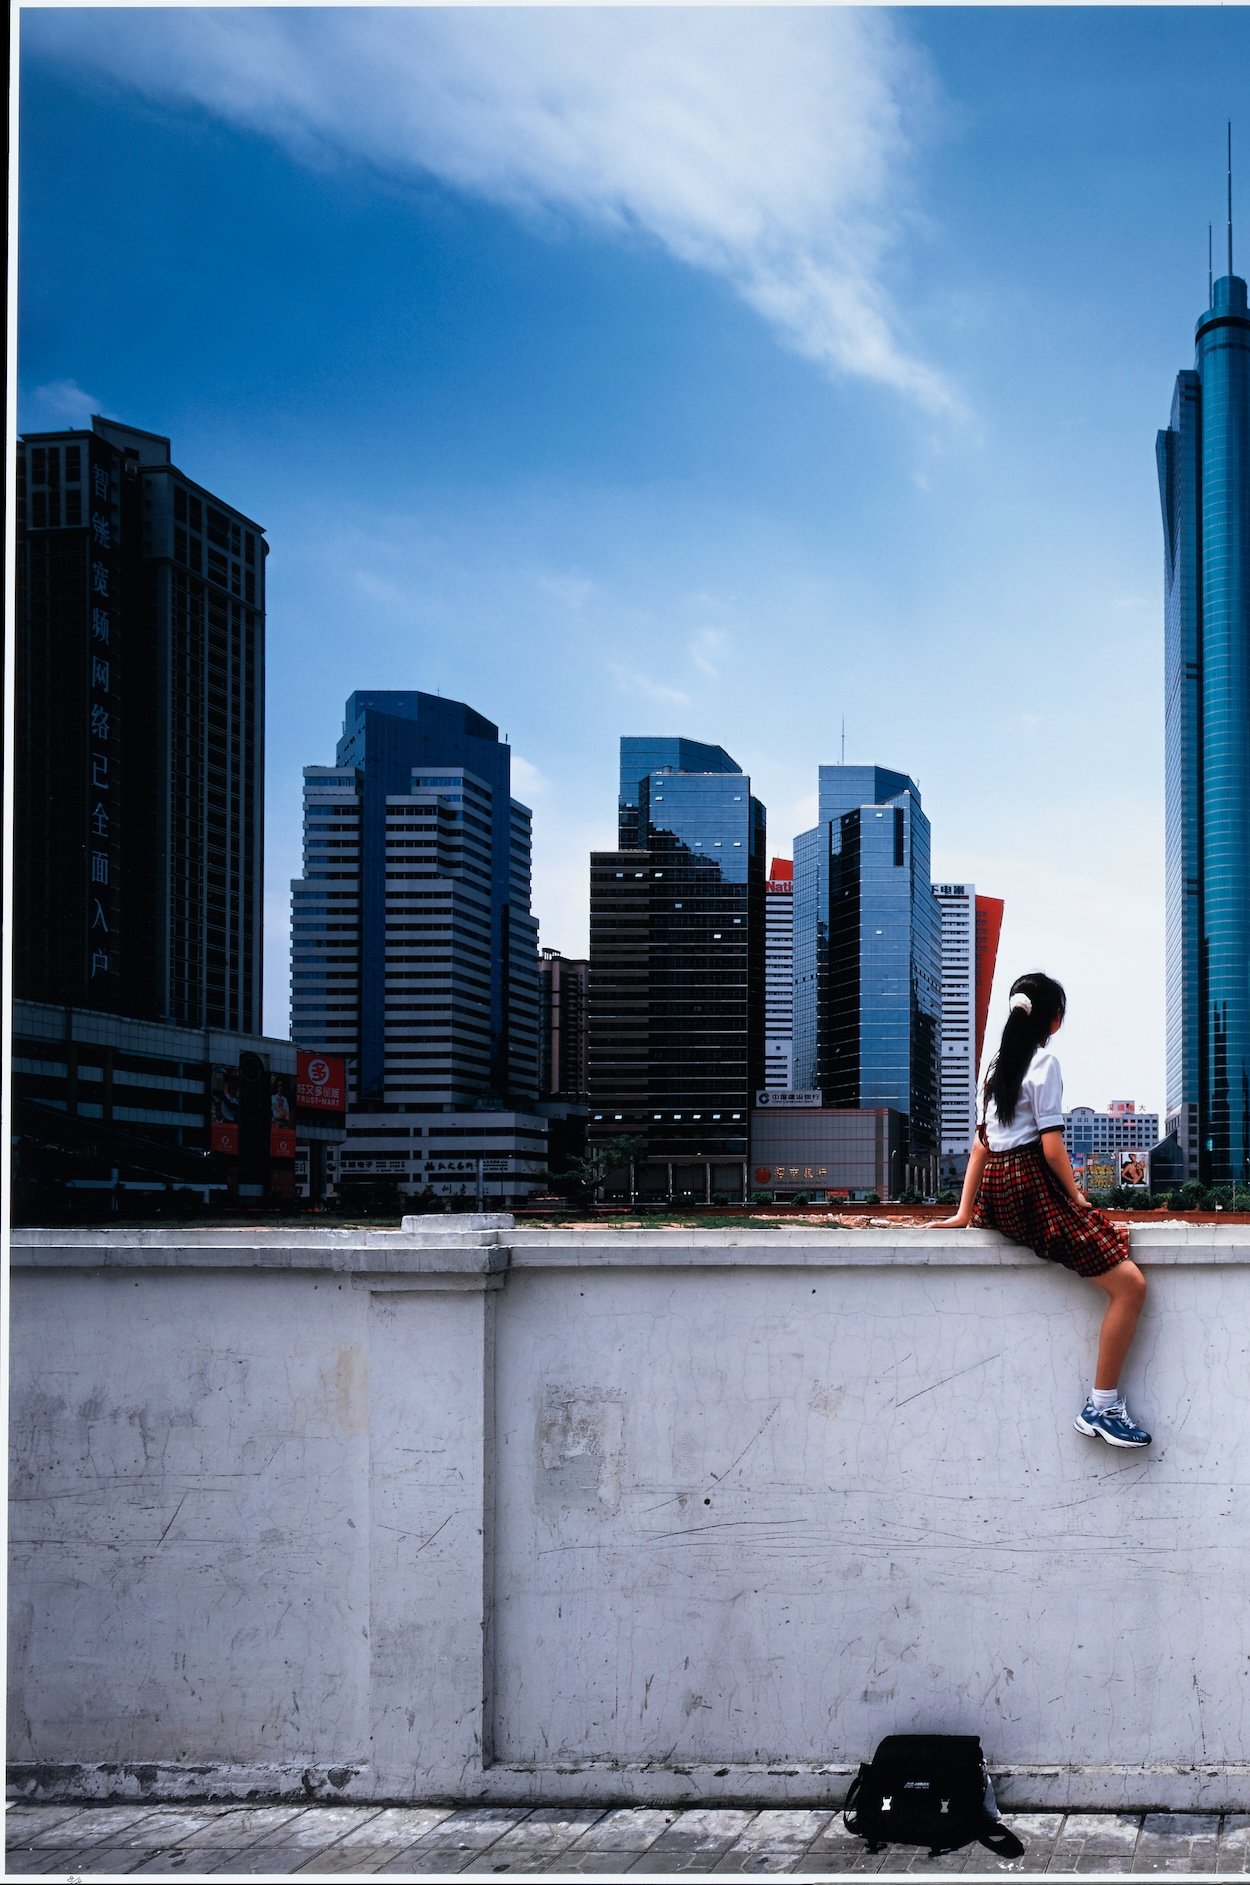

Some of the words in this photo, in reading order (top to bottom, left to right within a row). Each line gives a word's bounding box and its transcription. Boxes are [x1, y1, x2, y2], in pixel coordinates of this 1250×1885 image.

[90, 463, 112, 979] 智能宽频网络已全面入户
[766, 881, 793, 892] Nati
[296, 1095, 340, 1106] TRUST-MART
